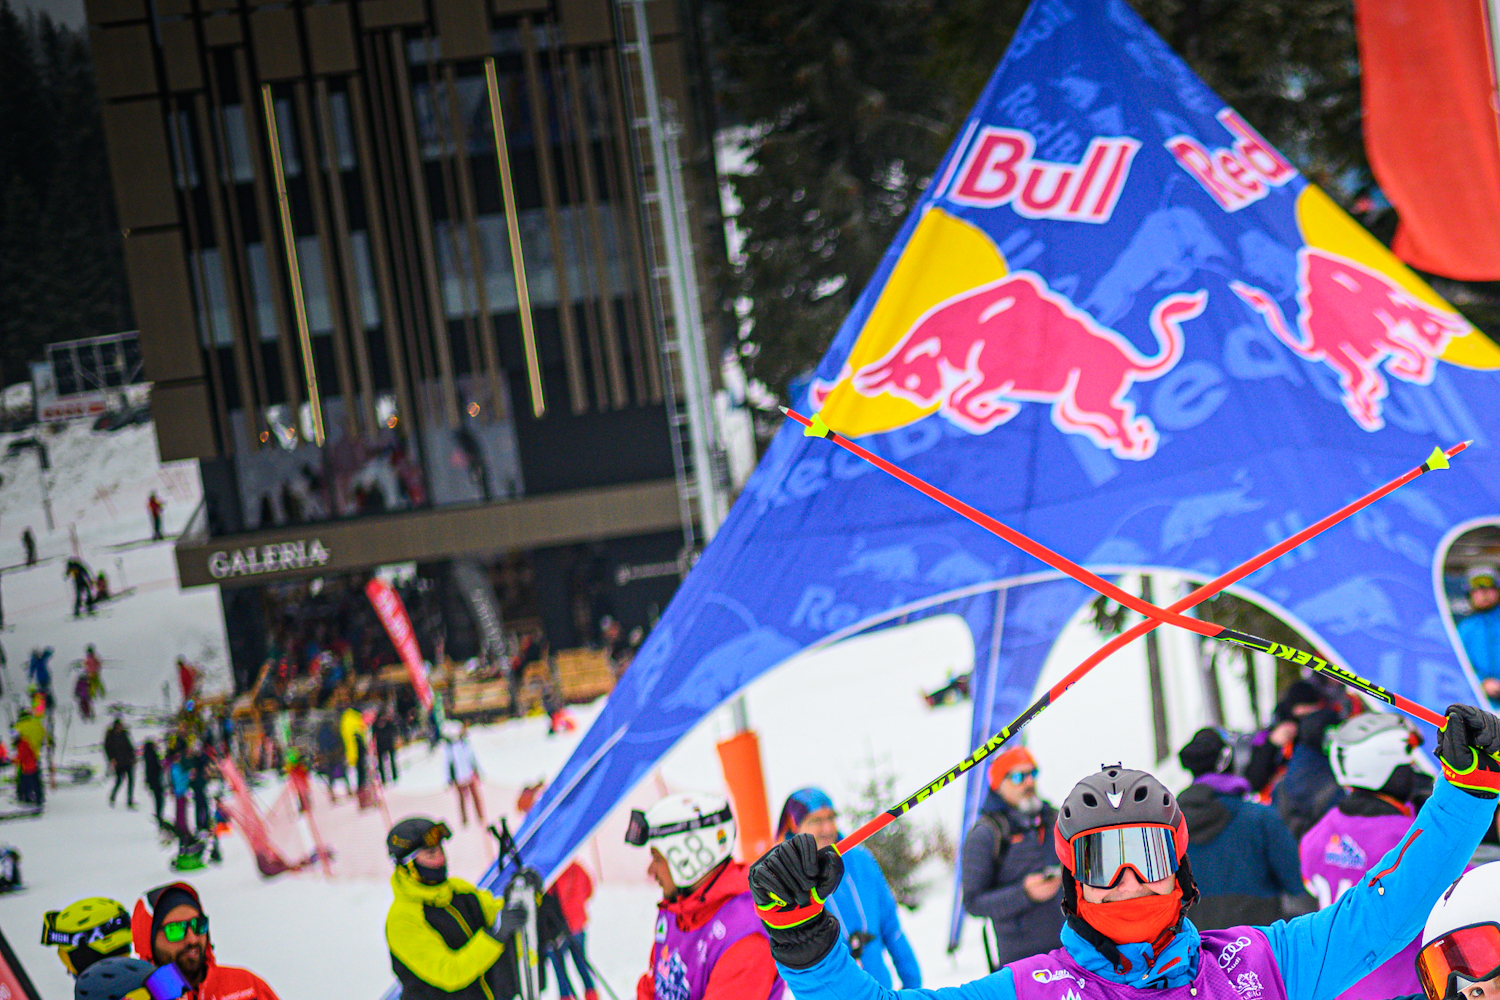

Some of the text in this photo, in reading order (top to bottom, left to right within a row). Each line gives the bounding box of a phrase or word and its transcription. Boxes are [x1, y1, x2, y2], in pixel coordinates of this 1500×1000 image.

[950, 126, 1143, 224] Bull
[1163, 107, 1299, 213] Red
[207, 539, 331, 579] GALERIA
[1266, 642, 1328, 672] LEKI
[958, 725, 1011, 773] LEKI
